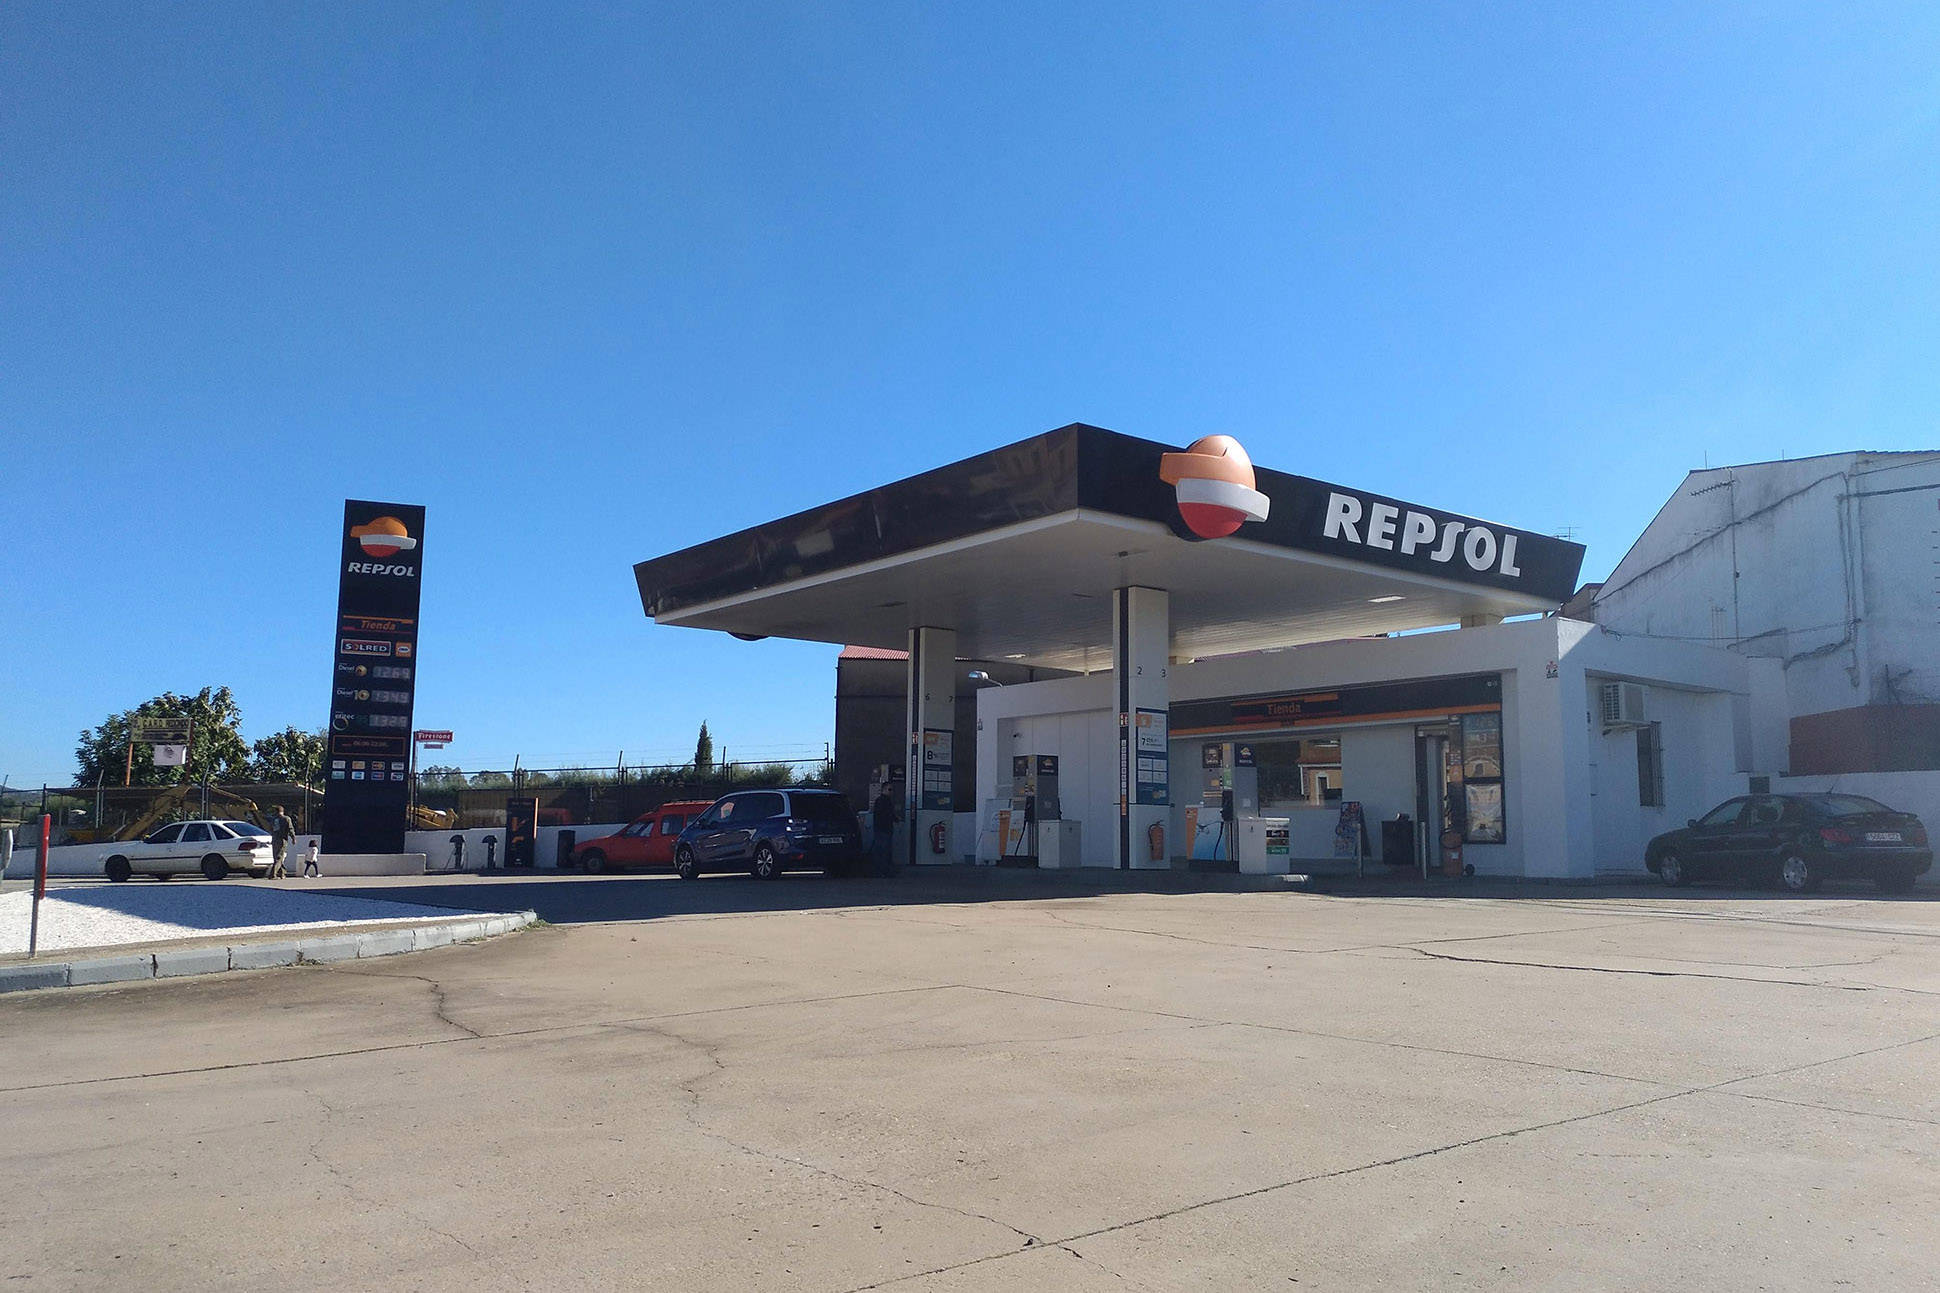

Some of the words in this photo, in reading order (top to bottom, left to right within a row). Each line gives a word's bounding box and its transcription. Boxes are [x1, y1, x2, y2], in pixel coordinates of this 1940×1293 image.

[1323, 492, 1521, 577] REPSOL
[348, 562, 415, 577] REPSOL
[361, 620, 396, 631] Tienda
[345, 643, 388, 652] SOLRED
[1137, 667, 1142, 676] 2
[1161, 669, 1166, 678] 3
[1266, 702, 1302, 715] Tienda
[417, 732, 452, 740] Firestone
